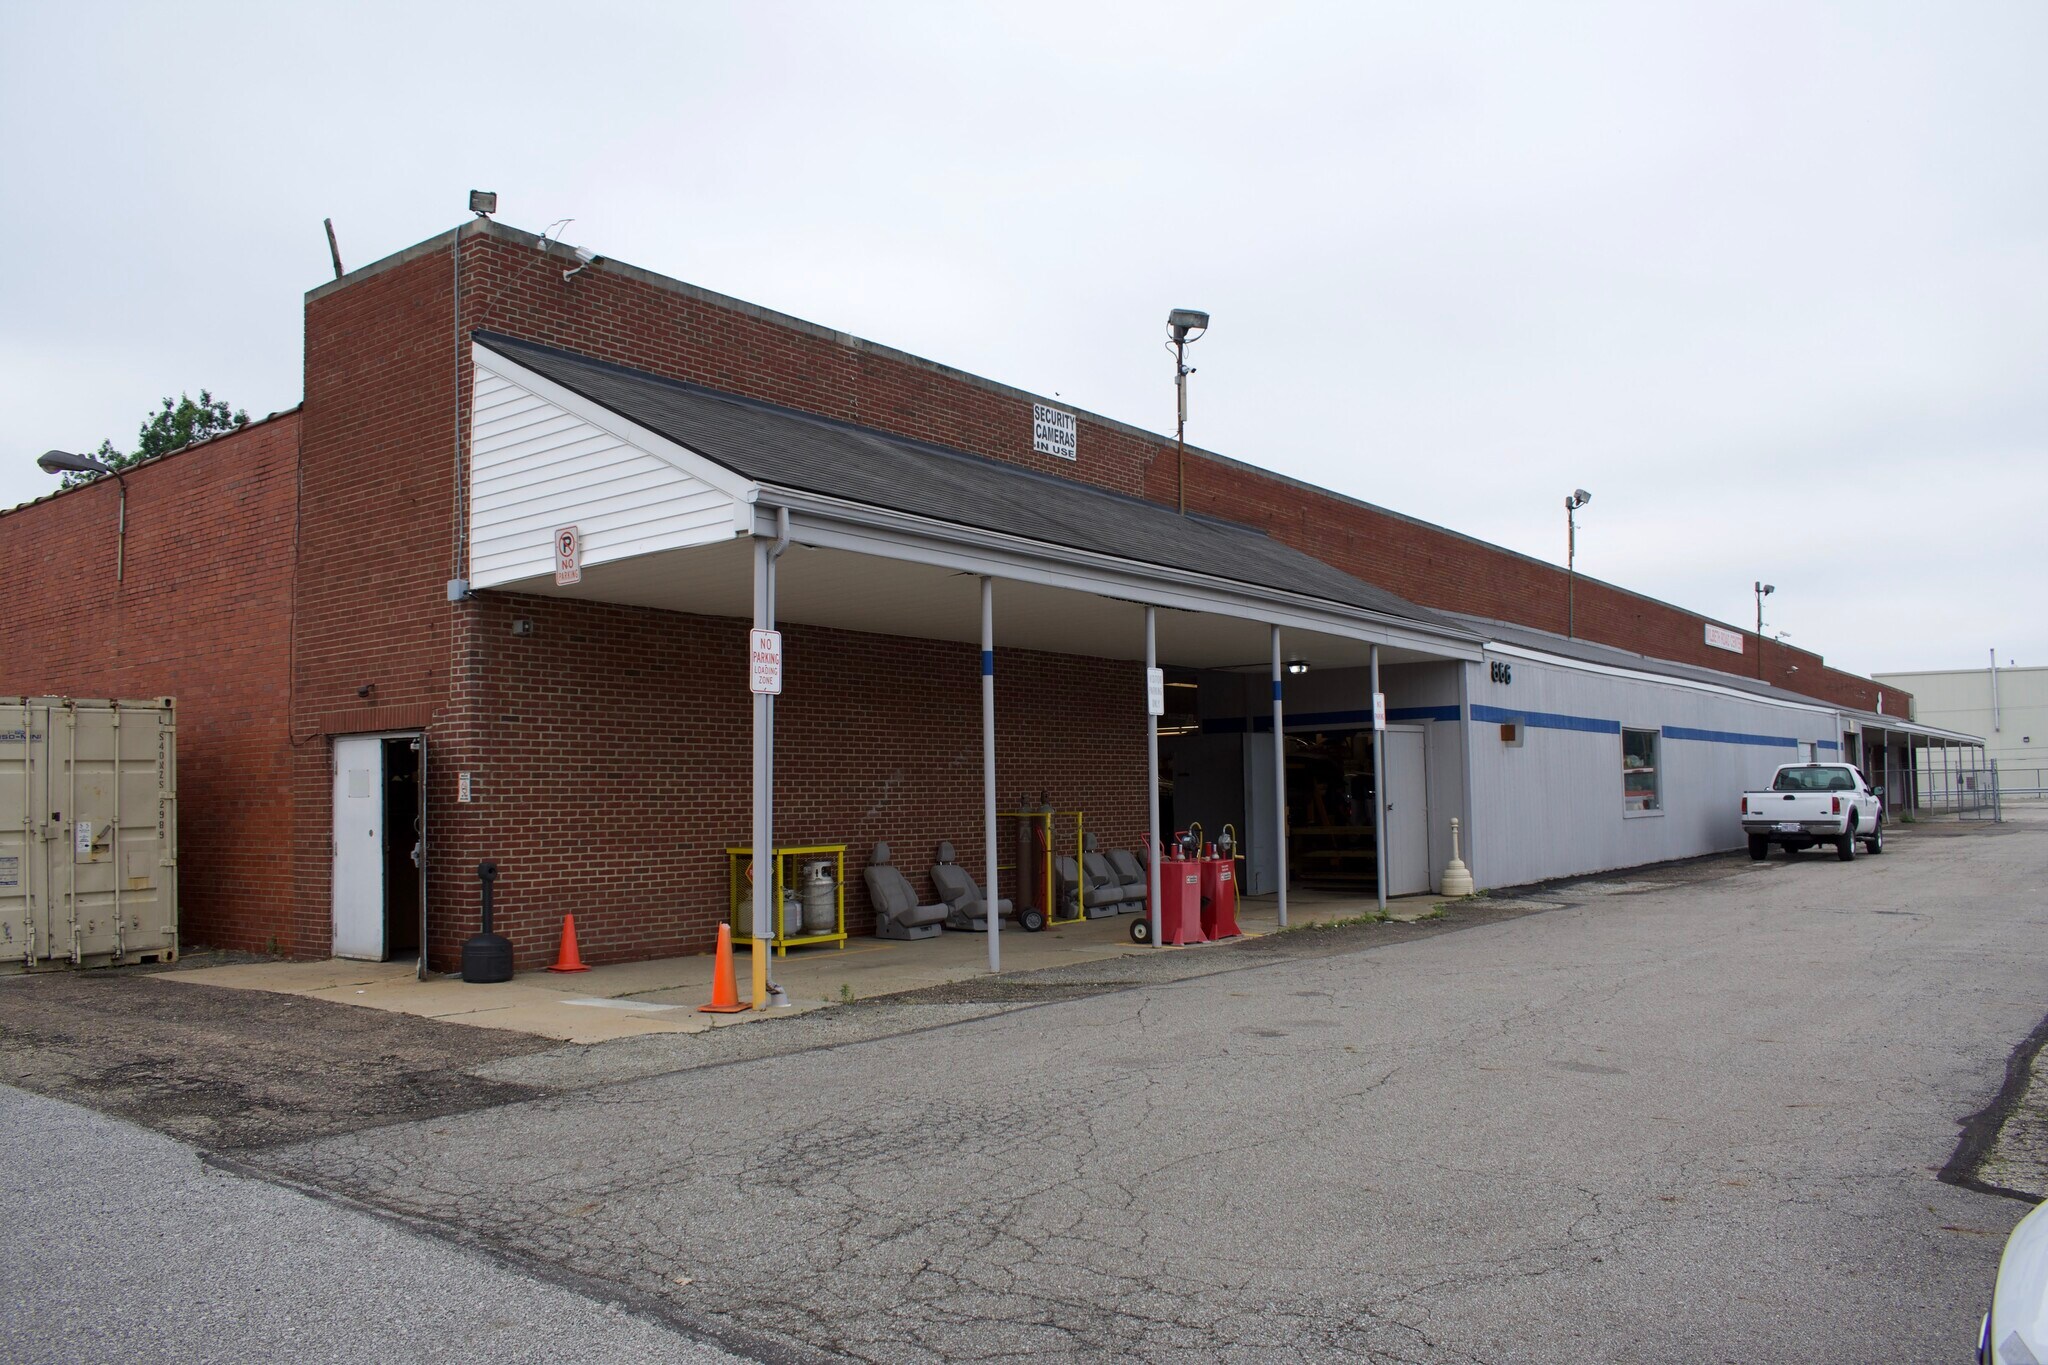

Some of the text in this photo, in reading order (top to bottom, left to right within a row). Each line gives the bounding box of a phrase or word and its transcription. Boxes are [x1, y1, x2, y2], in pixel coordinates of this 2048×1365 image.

[1034, 405, 1075, 430] SECURITY
[1035, 423, 1075, 448] CAMERAS
[1036, 441, 1075, 458] IN USE
[561, 558, 574, 570] NO
[558, 569, 578, 580] PARKING
[760, 638, 772, 650] NO
[753, 651, 780, 665] PARKING
[754, 666, 778, 676] LOADING
[1491, 661, 1511, 685] 866
[758, 675, 773, 685] ZONE
